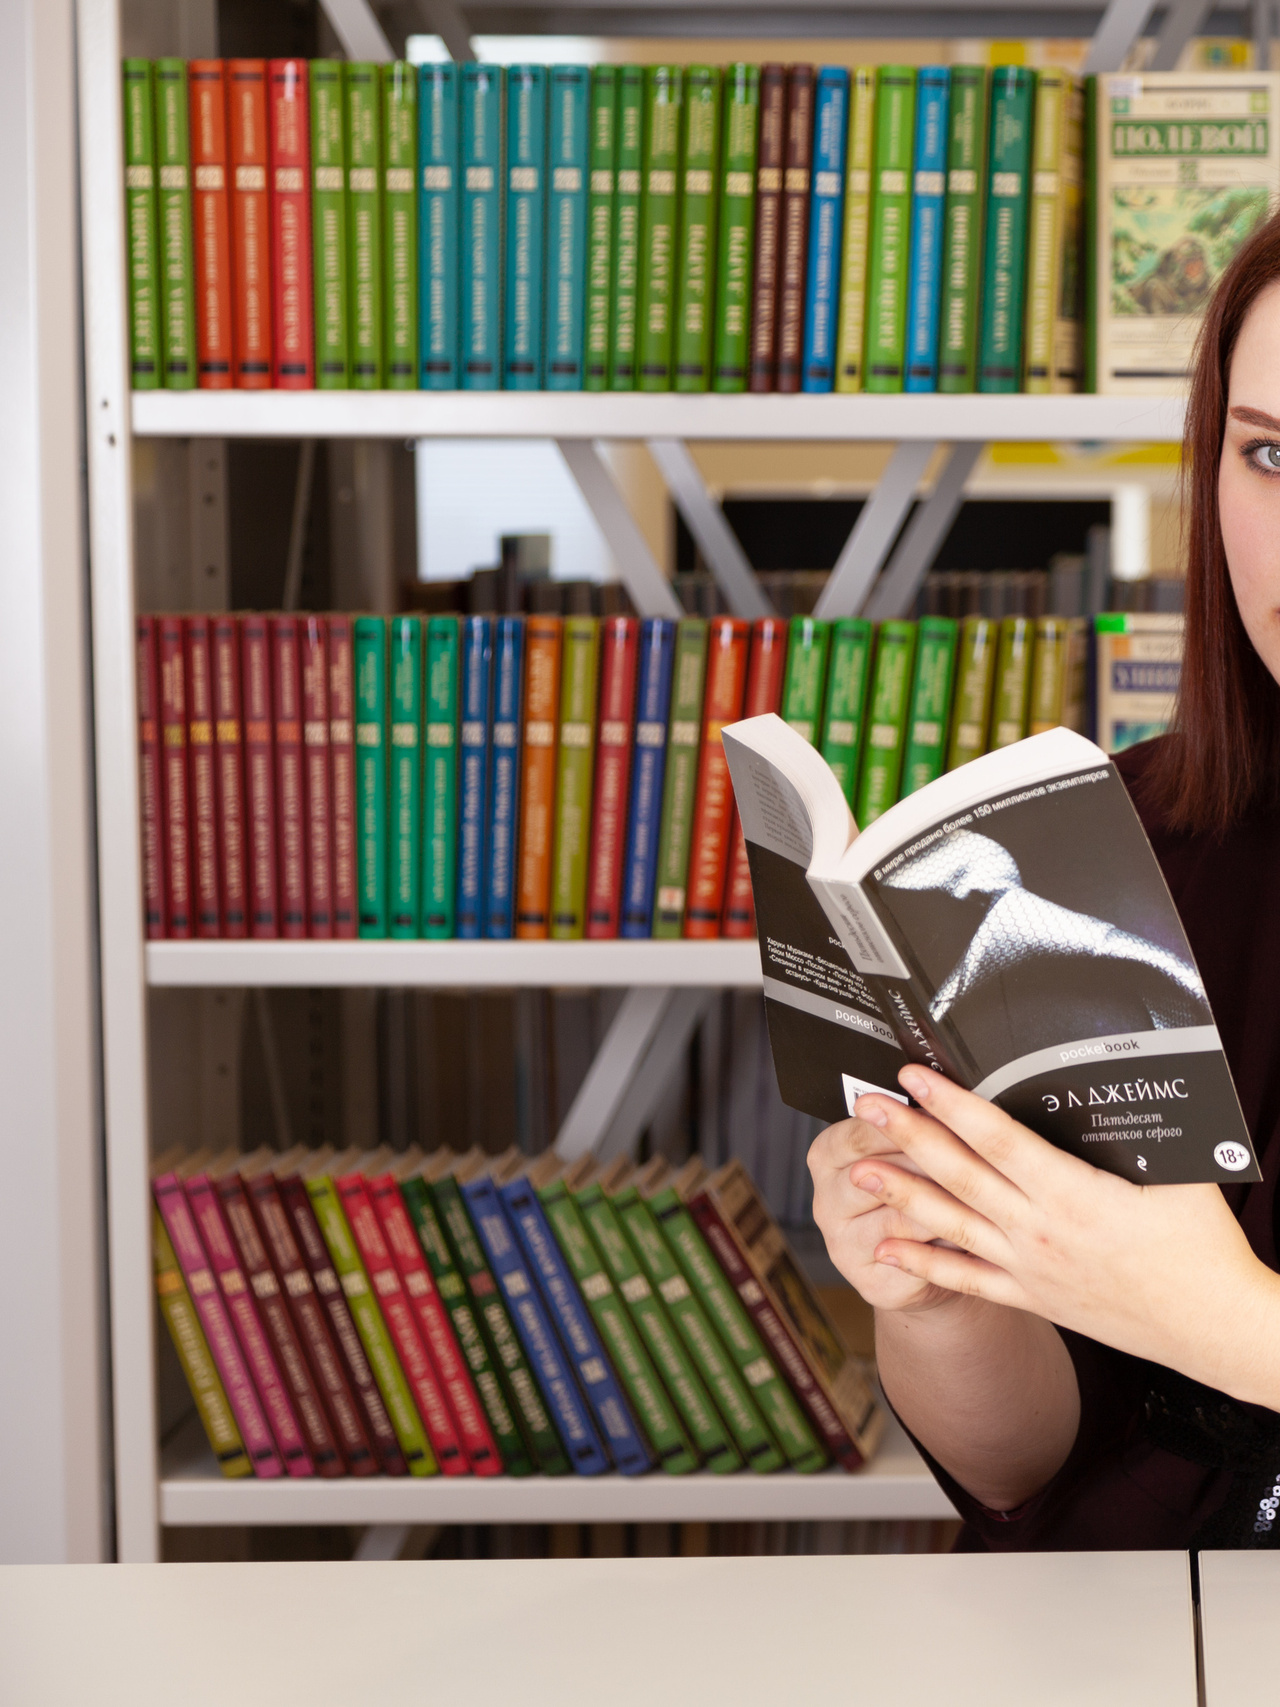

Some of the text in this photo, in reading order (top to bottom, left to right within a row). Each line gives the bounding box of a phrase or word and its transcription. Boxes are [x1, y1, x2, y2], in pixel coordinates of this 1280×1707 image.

[873, 769, 1109, 881] В мире продано более 150 миллионов экземпляров
[767, 936, 786, 949] Харуки
[787, 944, 814, 960] Мураками
[786, 952, 804, 964] Мюссо
[1059, 1039, 1140, 1063] pocketbook
[1042, 1077, 1189, 1112] Э Л ДЖЕЙМС
[1091, 1111, 1163, 1128] Пятьдесят
[1081, 1125, 1183, 1143] оттенков серого
[1219, 1148, 1246, 1165] 18+
